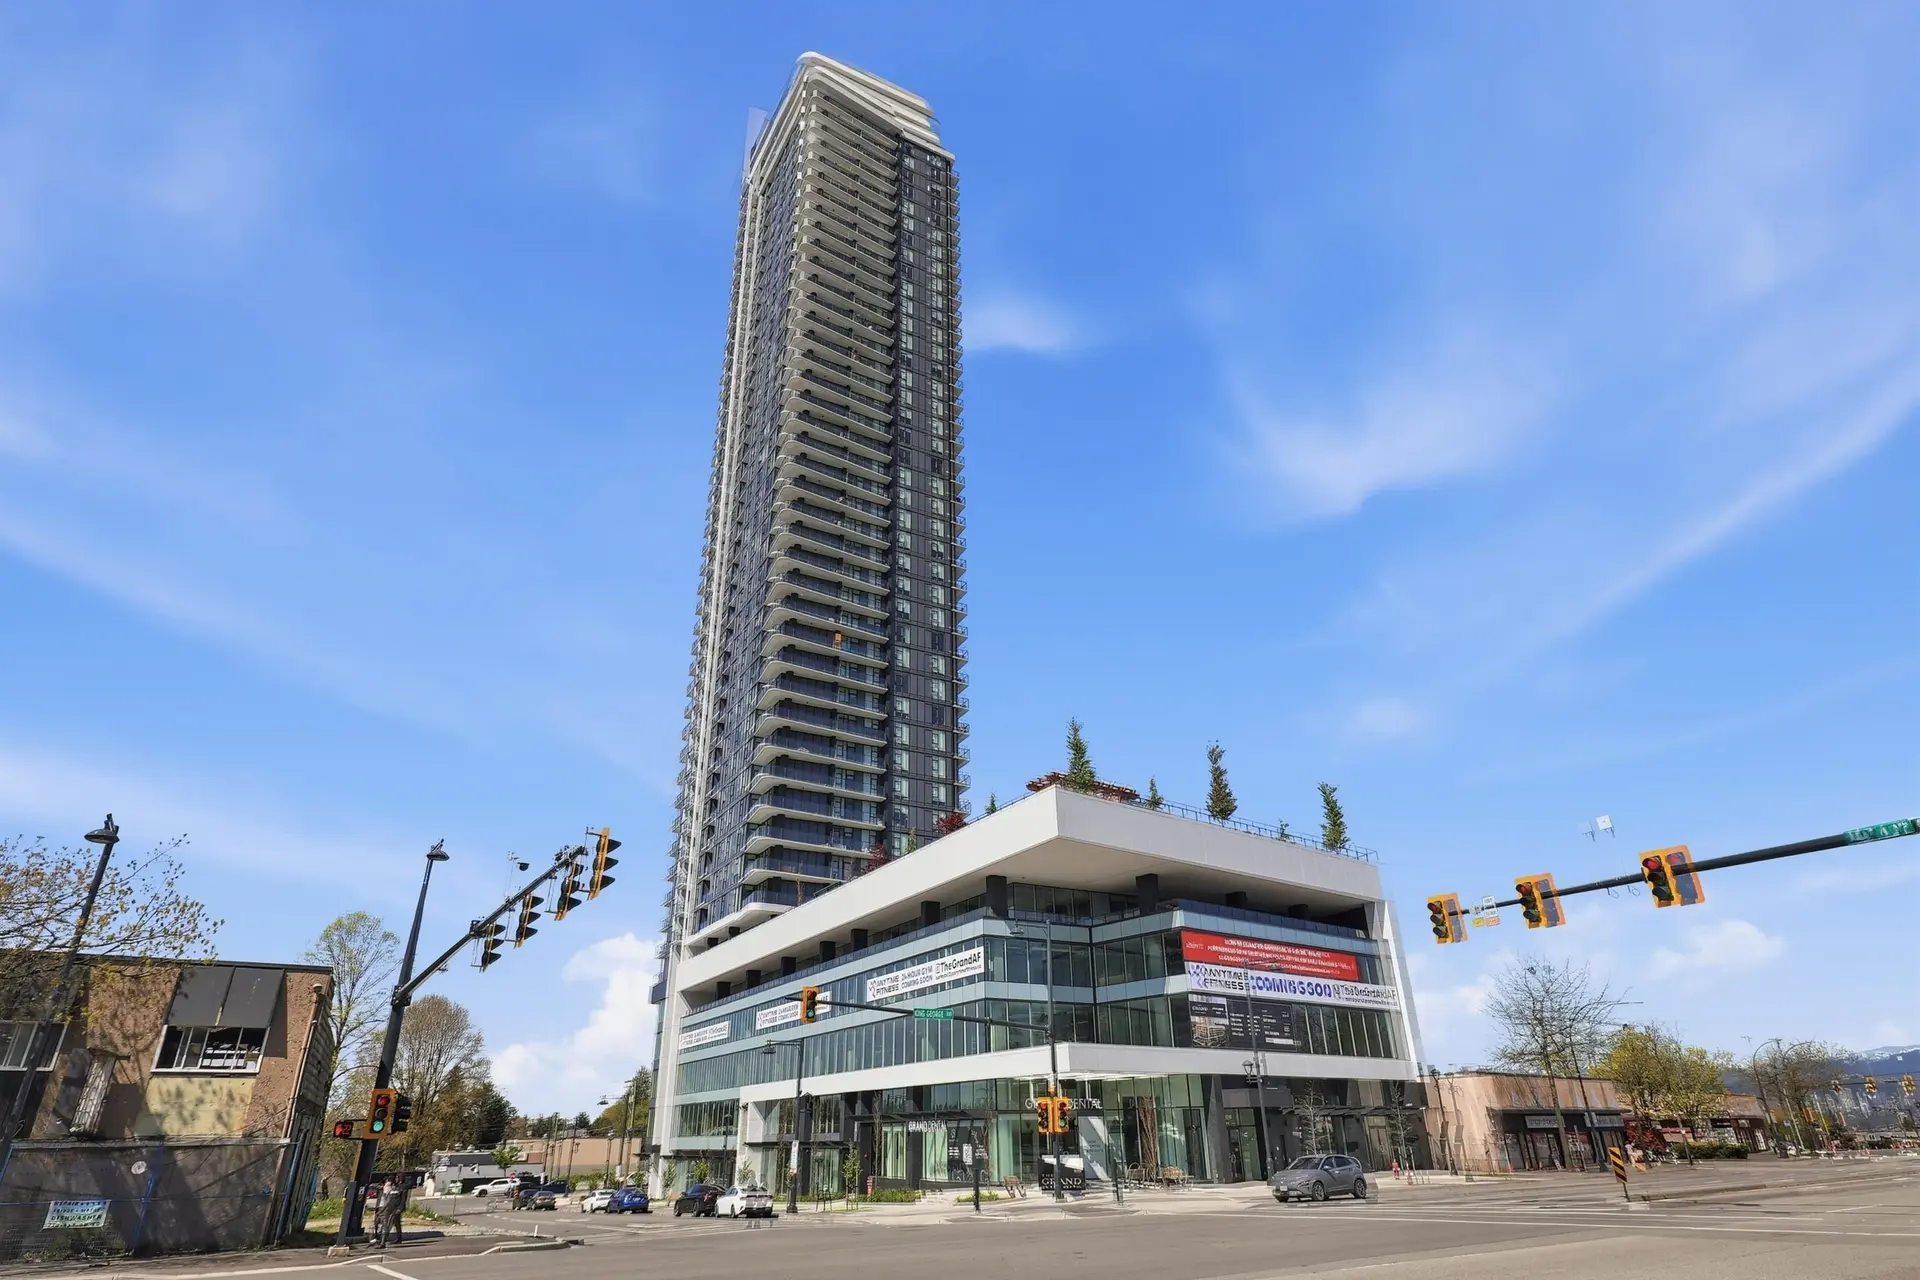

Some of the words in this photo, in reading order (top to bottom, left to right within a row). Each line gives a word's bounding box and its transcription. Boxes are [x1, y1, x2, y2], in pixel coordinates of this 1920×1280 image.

[875, 983, 899, 996] FITNESS
[926, 1010, 944, 1018] GEORGE
[908, 1121, 928, 1132] GRAND
